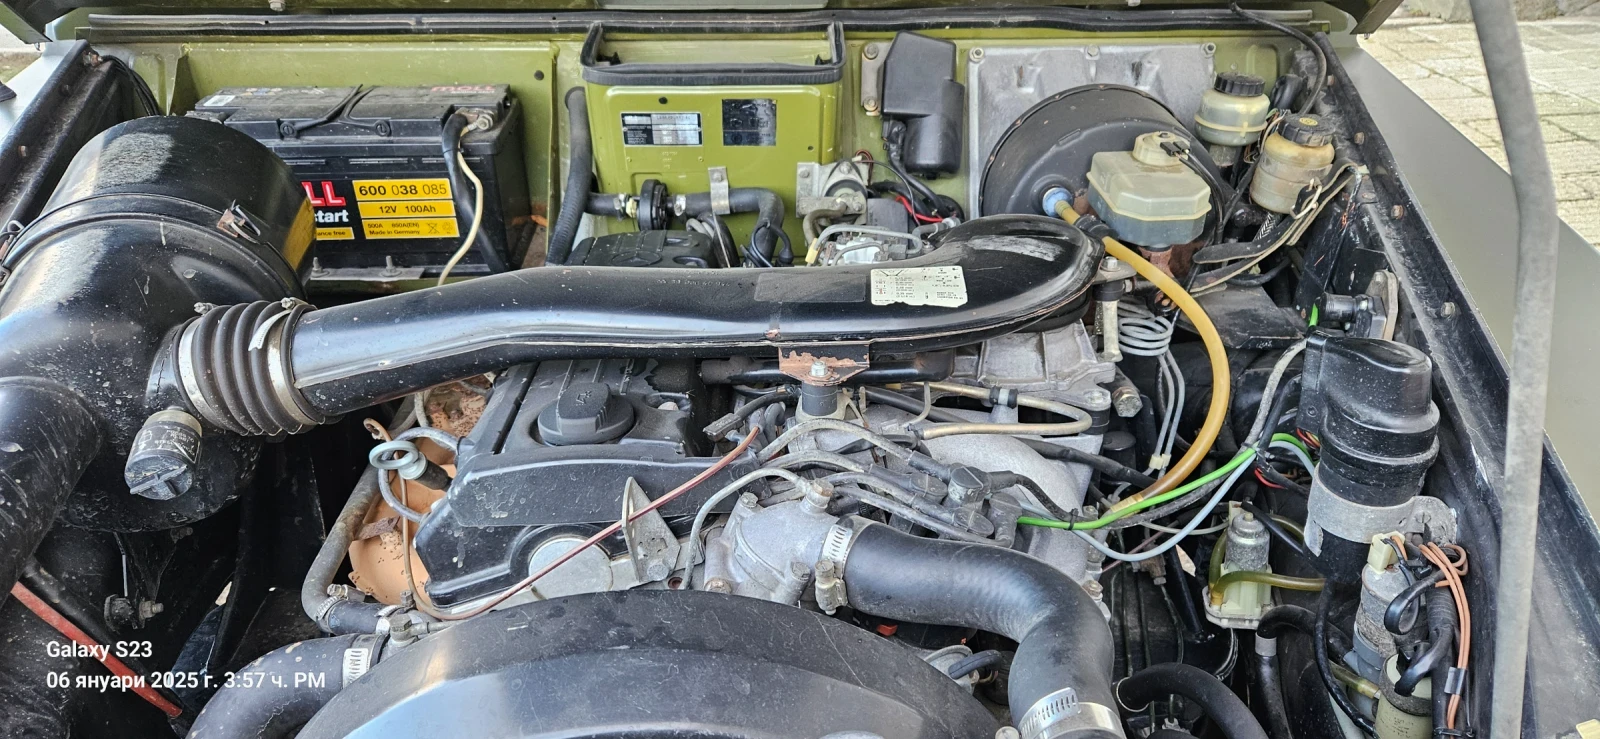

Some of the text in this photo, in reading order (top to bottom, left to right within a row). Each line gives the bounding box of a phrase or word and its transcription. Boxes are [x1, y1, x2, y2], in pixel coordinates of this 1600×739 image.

[301, 180, 346, 206] LL
[359, 183, 447, 196] 600 038 085
[379, 204, 436, 214] 12V 100Ah
